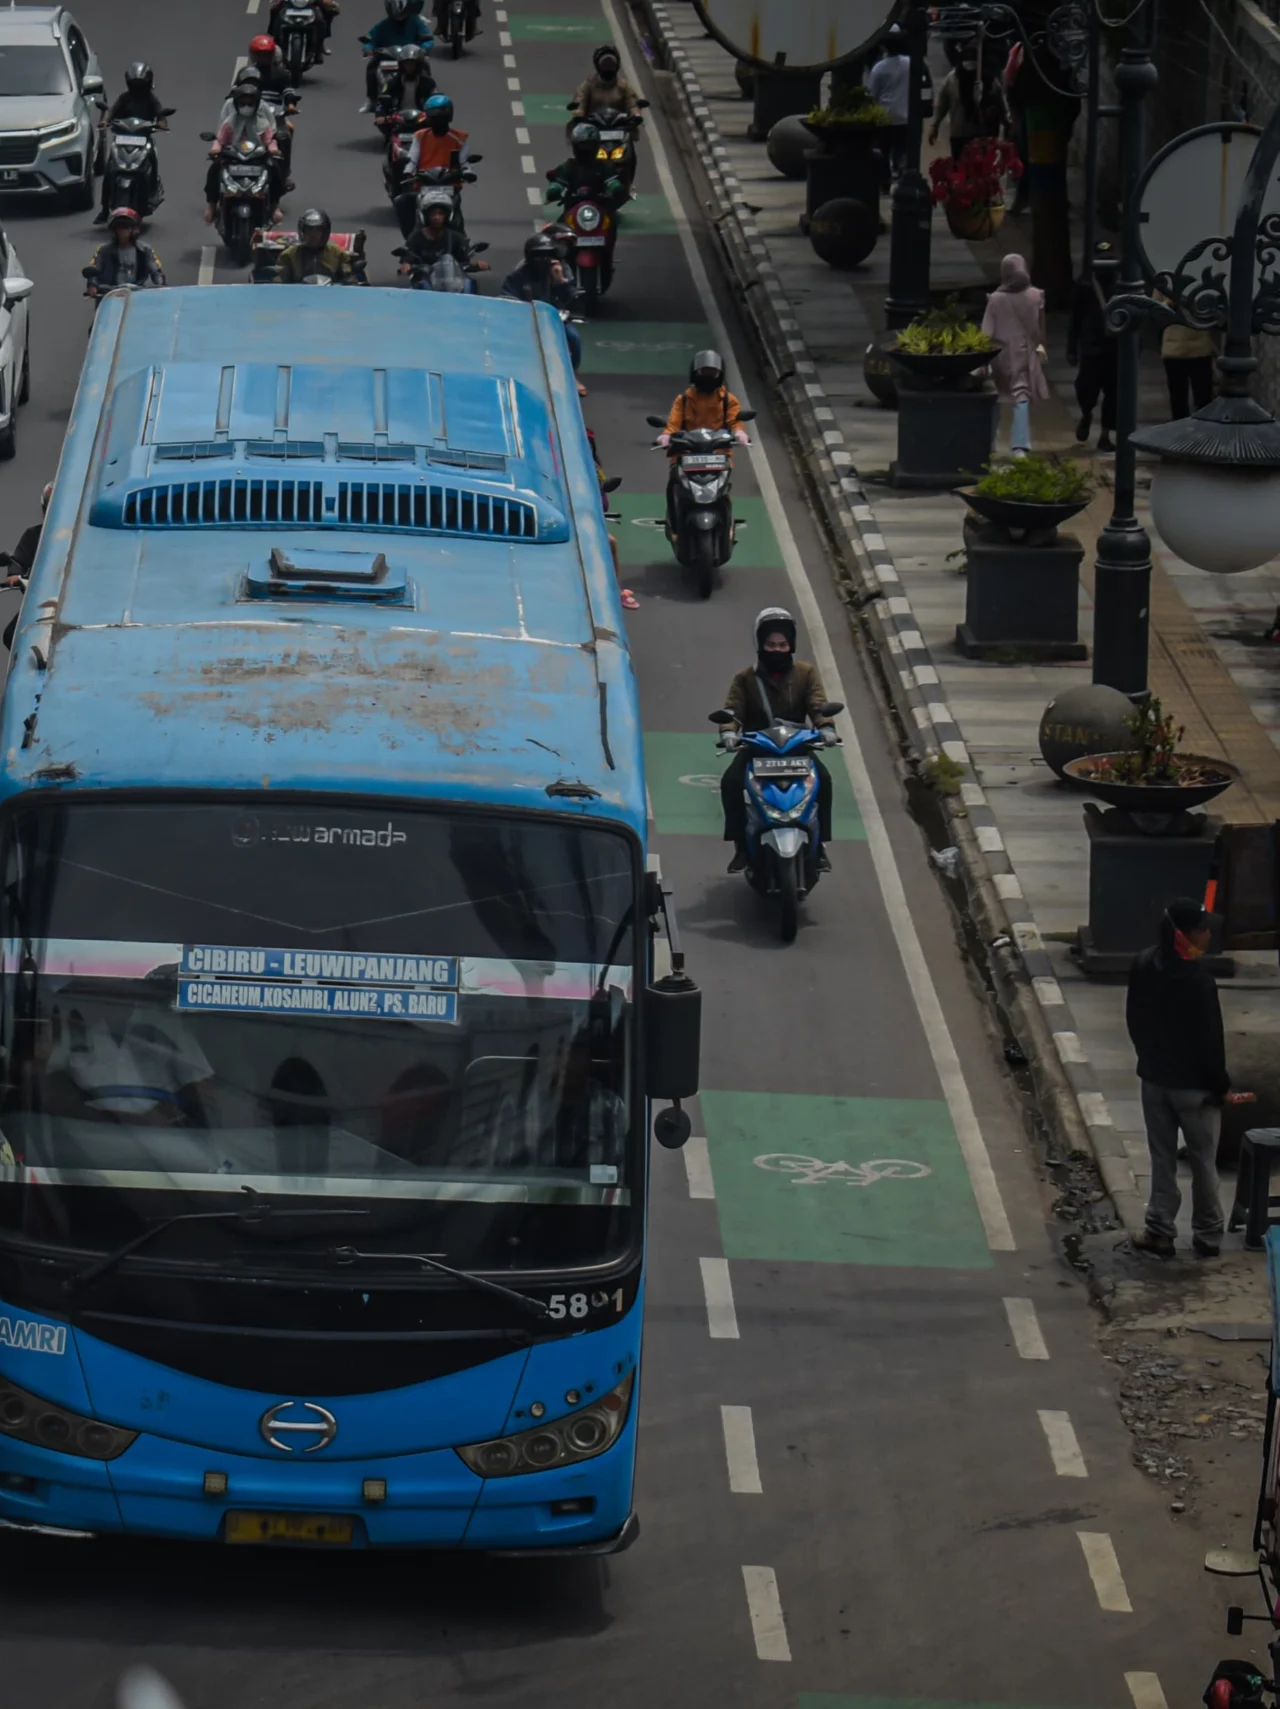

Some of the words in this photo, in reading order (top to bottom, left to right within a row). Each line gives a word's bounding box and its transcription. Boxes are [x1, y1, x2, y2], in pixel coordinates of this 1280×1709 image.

[314, 821, 408, 848] armada
[187, 947, 266, 974] CIBIRU
[283, 952, 449, 983] LEUWIPANJANG
[383, 992, 406, 1014] PS.
[408, 994, 448, 1016] BARU
